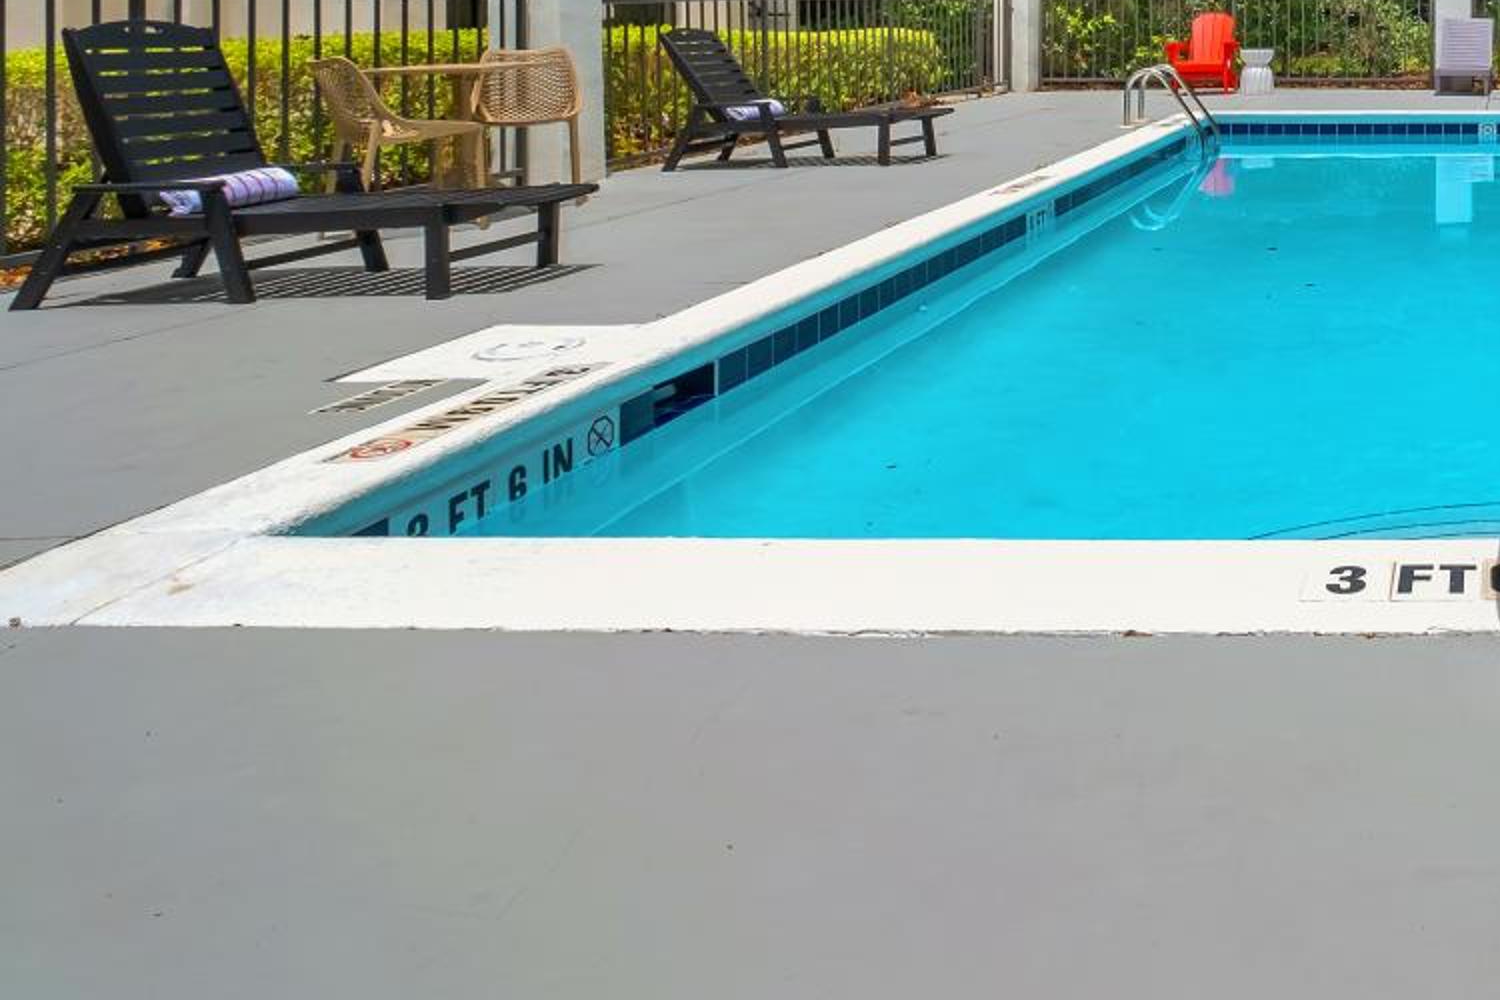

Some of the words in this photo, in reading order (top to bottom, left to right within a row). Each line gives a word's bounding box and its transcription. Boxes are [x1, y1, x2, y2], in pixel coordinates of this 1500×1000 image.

[448, 479, 490, 535] FT
[508, 464, 527, 502] 6
[543, 437, 573, 485] IN
[1325, 565, 1367, 594] 3
